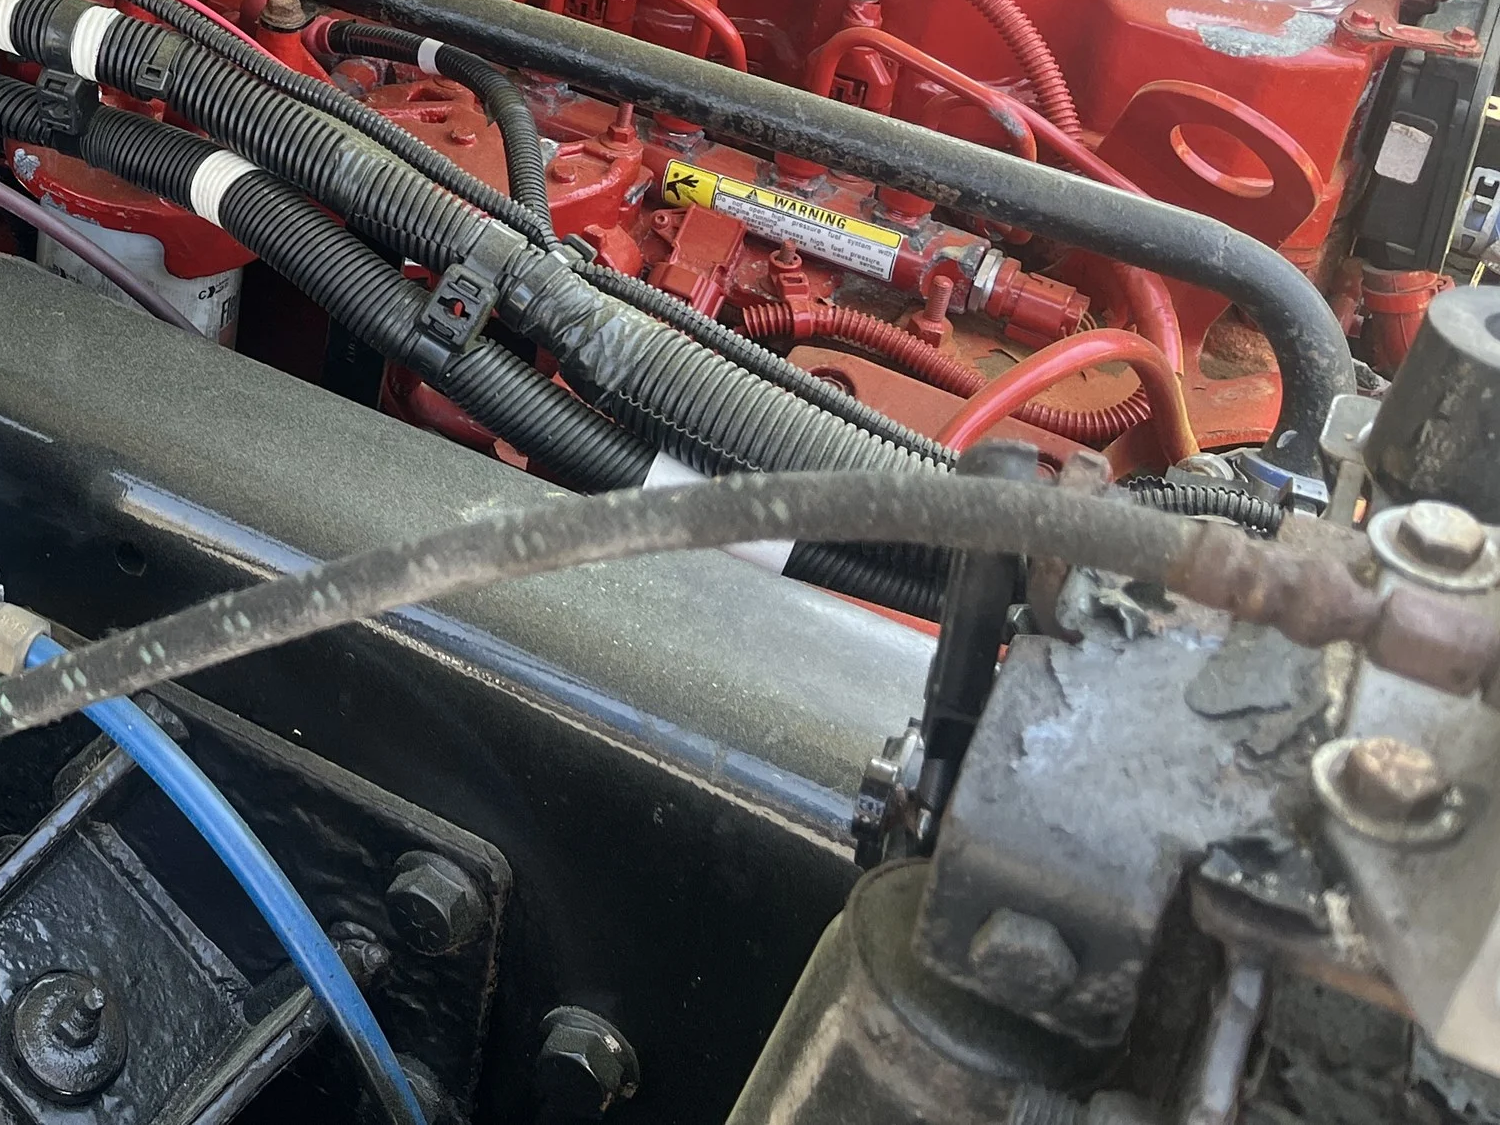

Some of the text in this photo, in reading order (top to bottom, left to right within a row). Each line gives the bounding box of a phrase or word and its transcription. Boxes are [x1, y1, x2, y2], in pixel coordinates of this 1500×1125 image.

[716, 194, 893, 258] Do not open high pressure fuel system with
[728, 205, 750, 217] engine
[774, 195, 847, 230] WARNING
[743, 215, 774, 231] operation
[780, 228, 804, 240] causes
[809, 237, 825, 248] high
[831, 244, 844, 254] fuel
